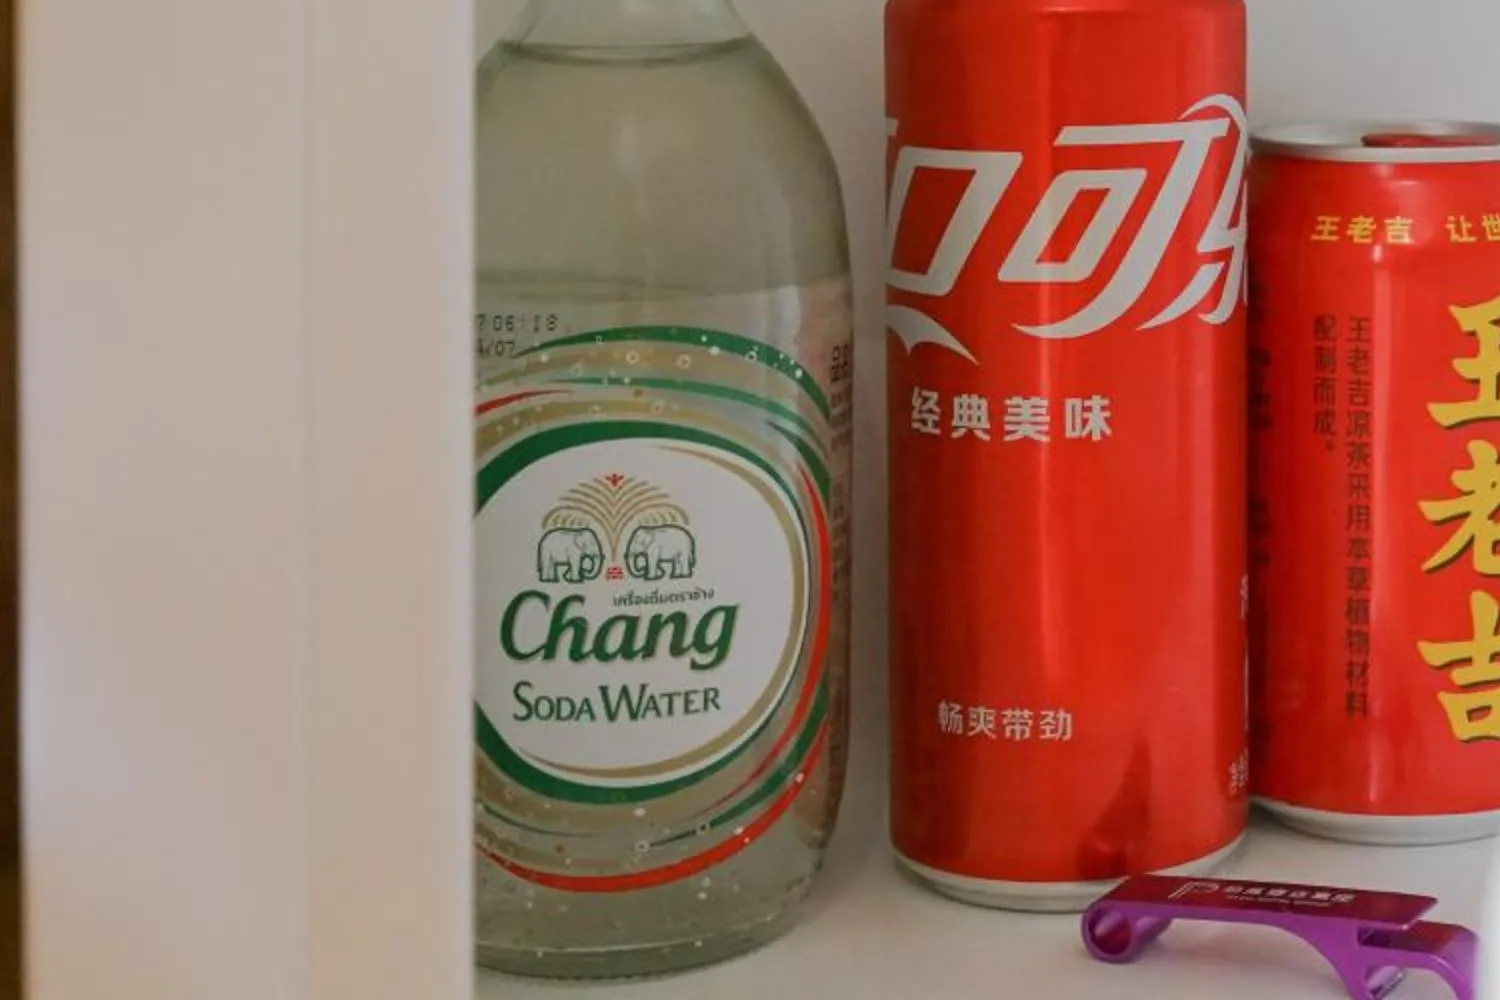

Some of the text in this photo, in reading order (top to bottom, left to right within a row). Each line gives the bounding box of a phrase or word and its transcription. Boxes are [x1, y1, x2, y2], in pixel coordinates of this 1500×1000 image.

[1311, 215, 1414, 245] 王老吉
[911, 386, 1113, 442] 经典美味
[500, 589, 739, 671] Chang
[938, 699, 1074, 742] 畅爽带劲
